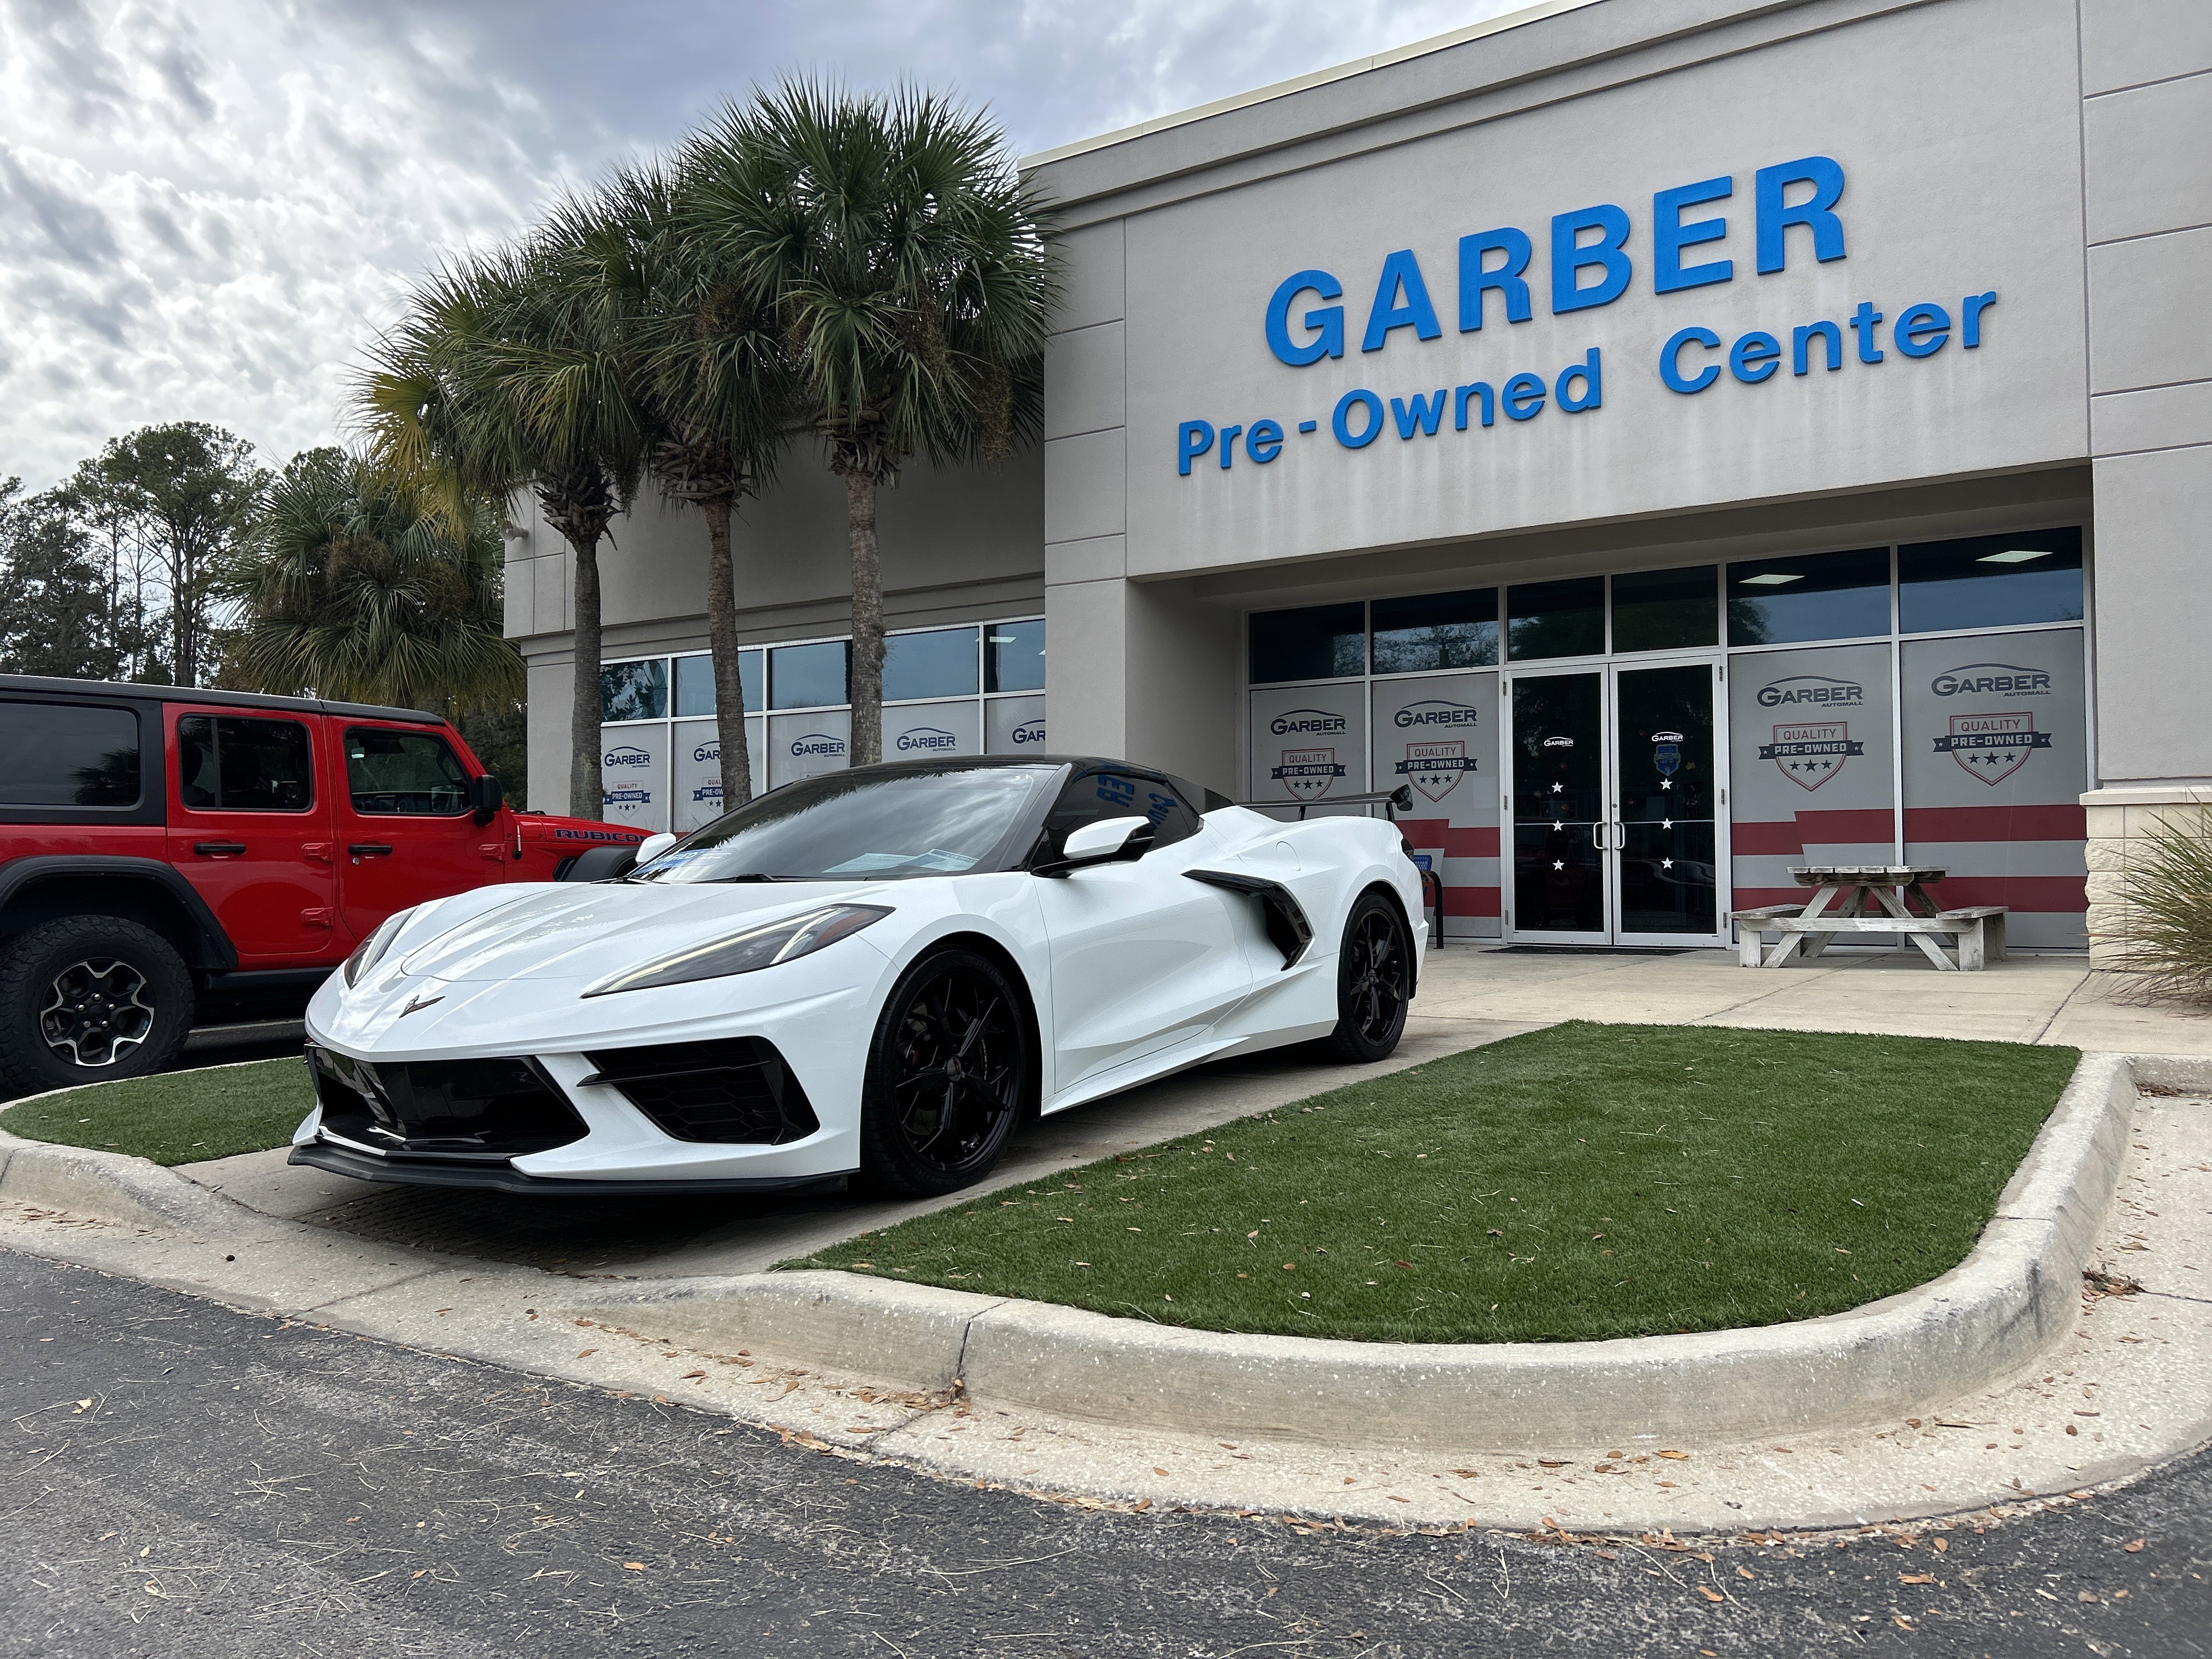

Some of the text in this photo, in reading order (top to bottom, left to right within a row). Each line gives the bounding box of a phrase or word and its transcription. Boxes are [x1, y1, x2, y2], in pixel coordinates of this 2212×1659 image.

[1265, 156, 1847, 366] GARBER
[1659, 291, 1997, 394] Center
[1931, 674, 2051, 697] GARBER
[1757, 686, 1864, 707] GARBER
[1394, 709, 1477, 728] GARBER
[1961, 719, 2021, 732] QUALITY
[1271, 718, 1346, 735] GARBER
[1012, 727, 1046, 744] GAR
[1784, 728, 1837, 740] QUALITY
[1950, 734, 2033, 747] PRE-OWNED
[791, 742, 845, 757] GARBER
[896, 735, 956, 751] GARBER
[1774, 743, 1847, 754] PRE-OWNED
[693, 748, 720, 762] GAR
[1289, 753, 1327, 763] QUALITY
[1414, 747, 1457, 757] QUALITY
[604, 753, 651, 767] GARBER
[1407, 759, 1465, 770] PRE-OWNED
[1282, 765, 1335, 775] PRE-OWNED
[612, 792, 643, 800] PRE-OWNED
